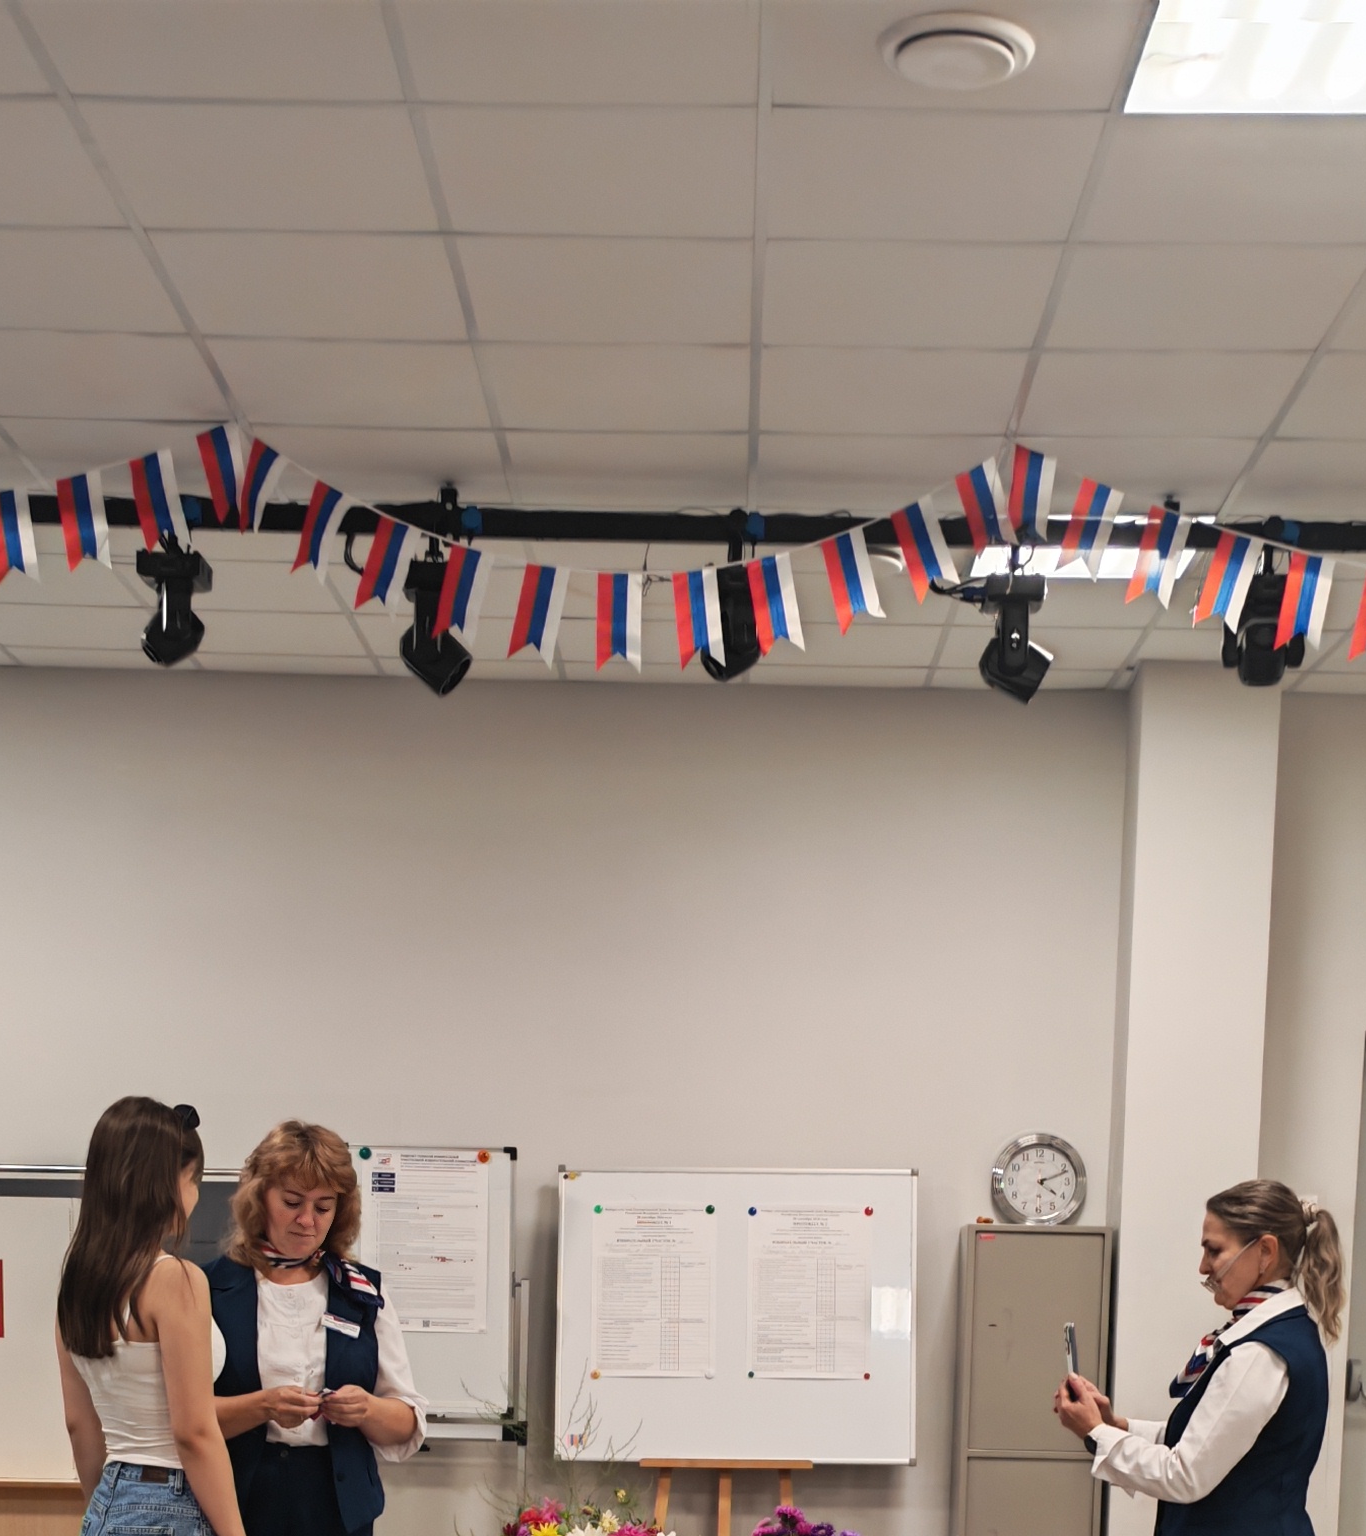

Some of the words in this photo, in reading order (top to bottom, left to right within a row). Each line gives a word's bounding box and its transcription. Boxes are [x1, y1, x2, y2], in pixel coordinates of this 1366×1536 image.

[1022, 1153, 1030, 1162] 11
[1035, 1149, 1045, 1158] 12
[1011, 1163, 1020, 1172] 10
[1060, 1163, 1067, 1172] 2
[1008, 1178, 1014, 1186] 9
[1064, 1178, 1071, 1187] 3
[1011, 1191, 1018, 1199] 8
[1059, 1191, 1066, 1200] 4
[1021, 1201, 1028, 1210] 7
[1035, 1204, 1042, 1214] 6
[1049, 1202, 1056, 1211] 5
